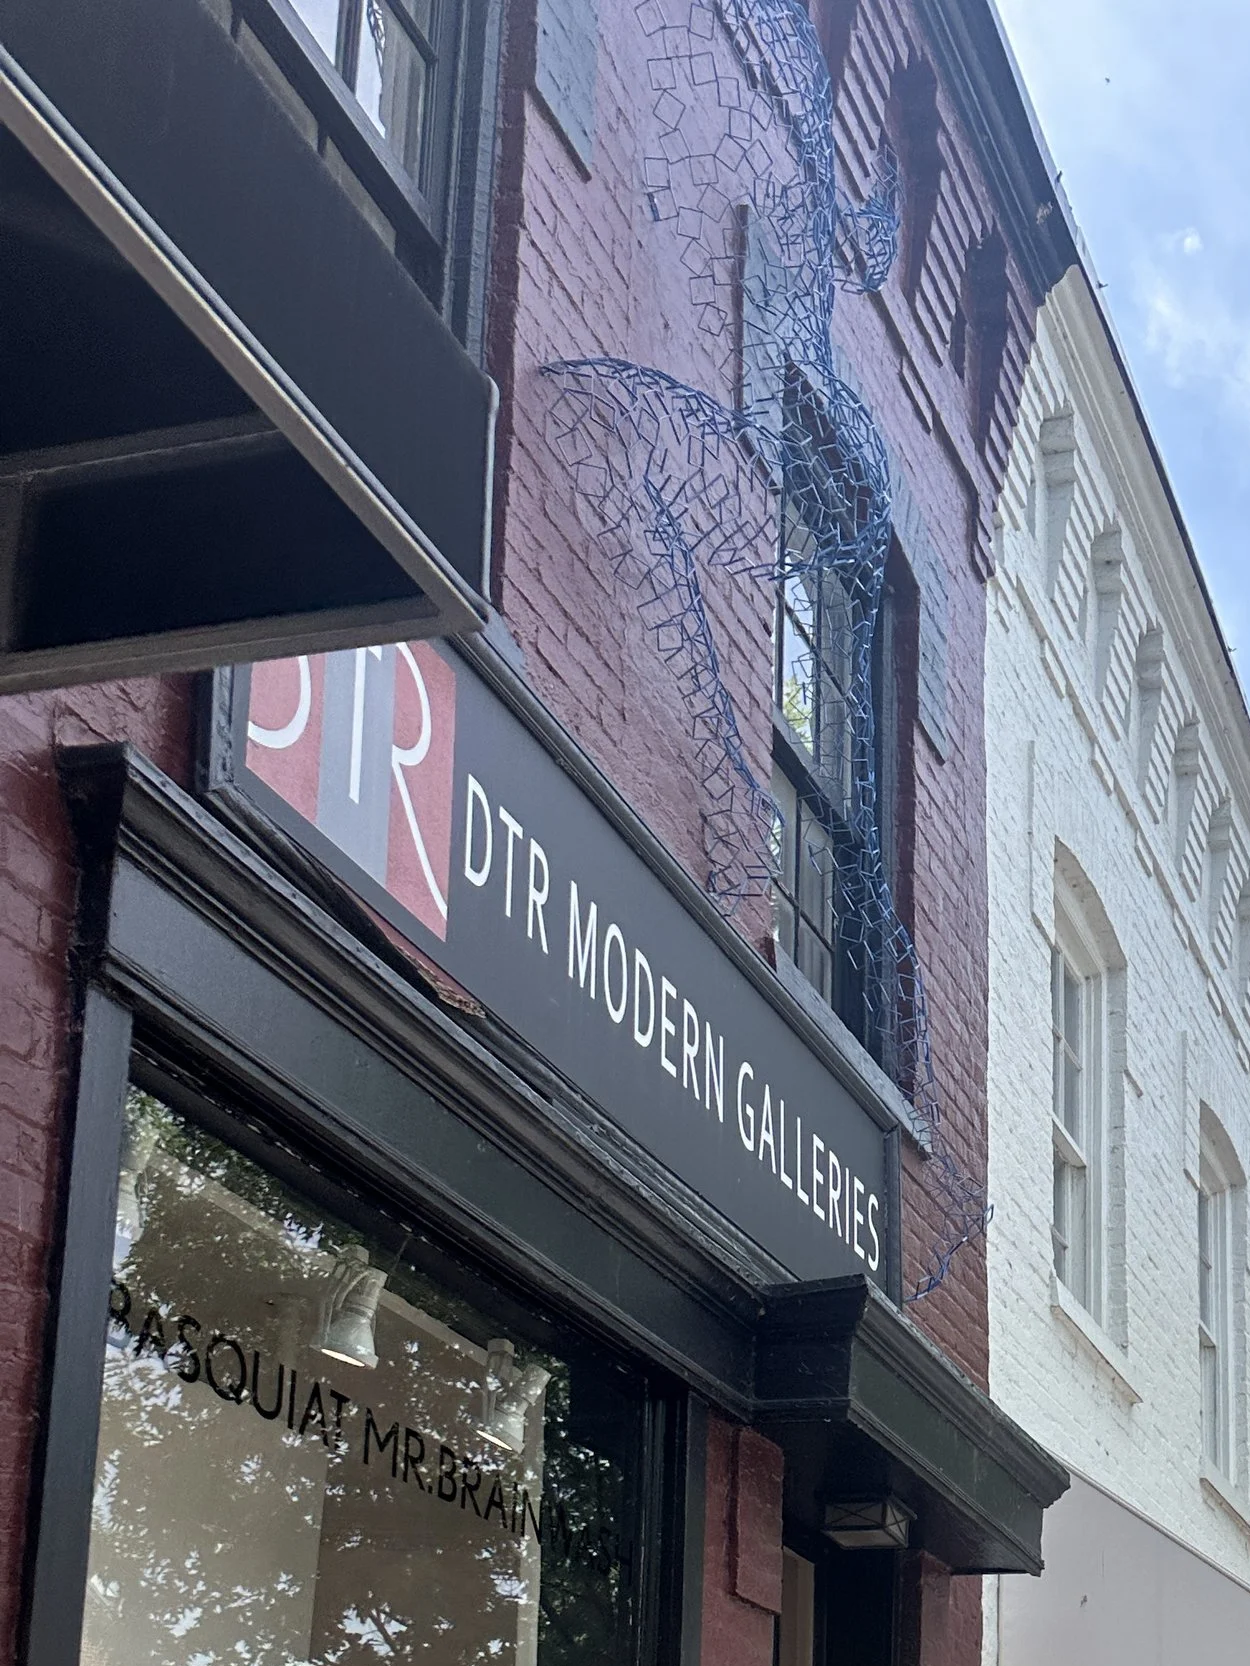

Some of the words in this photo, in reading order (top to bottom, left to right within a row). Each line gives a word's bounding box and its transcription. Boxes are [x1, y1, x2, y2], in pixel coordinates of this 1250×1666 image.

[464, 773, 550, 954] DTR
[568, 880, 724, 1123] MODERN
[736, 1061, 879, 1271] GALLERIES
